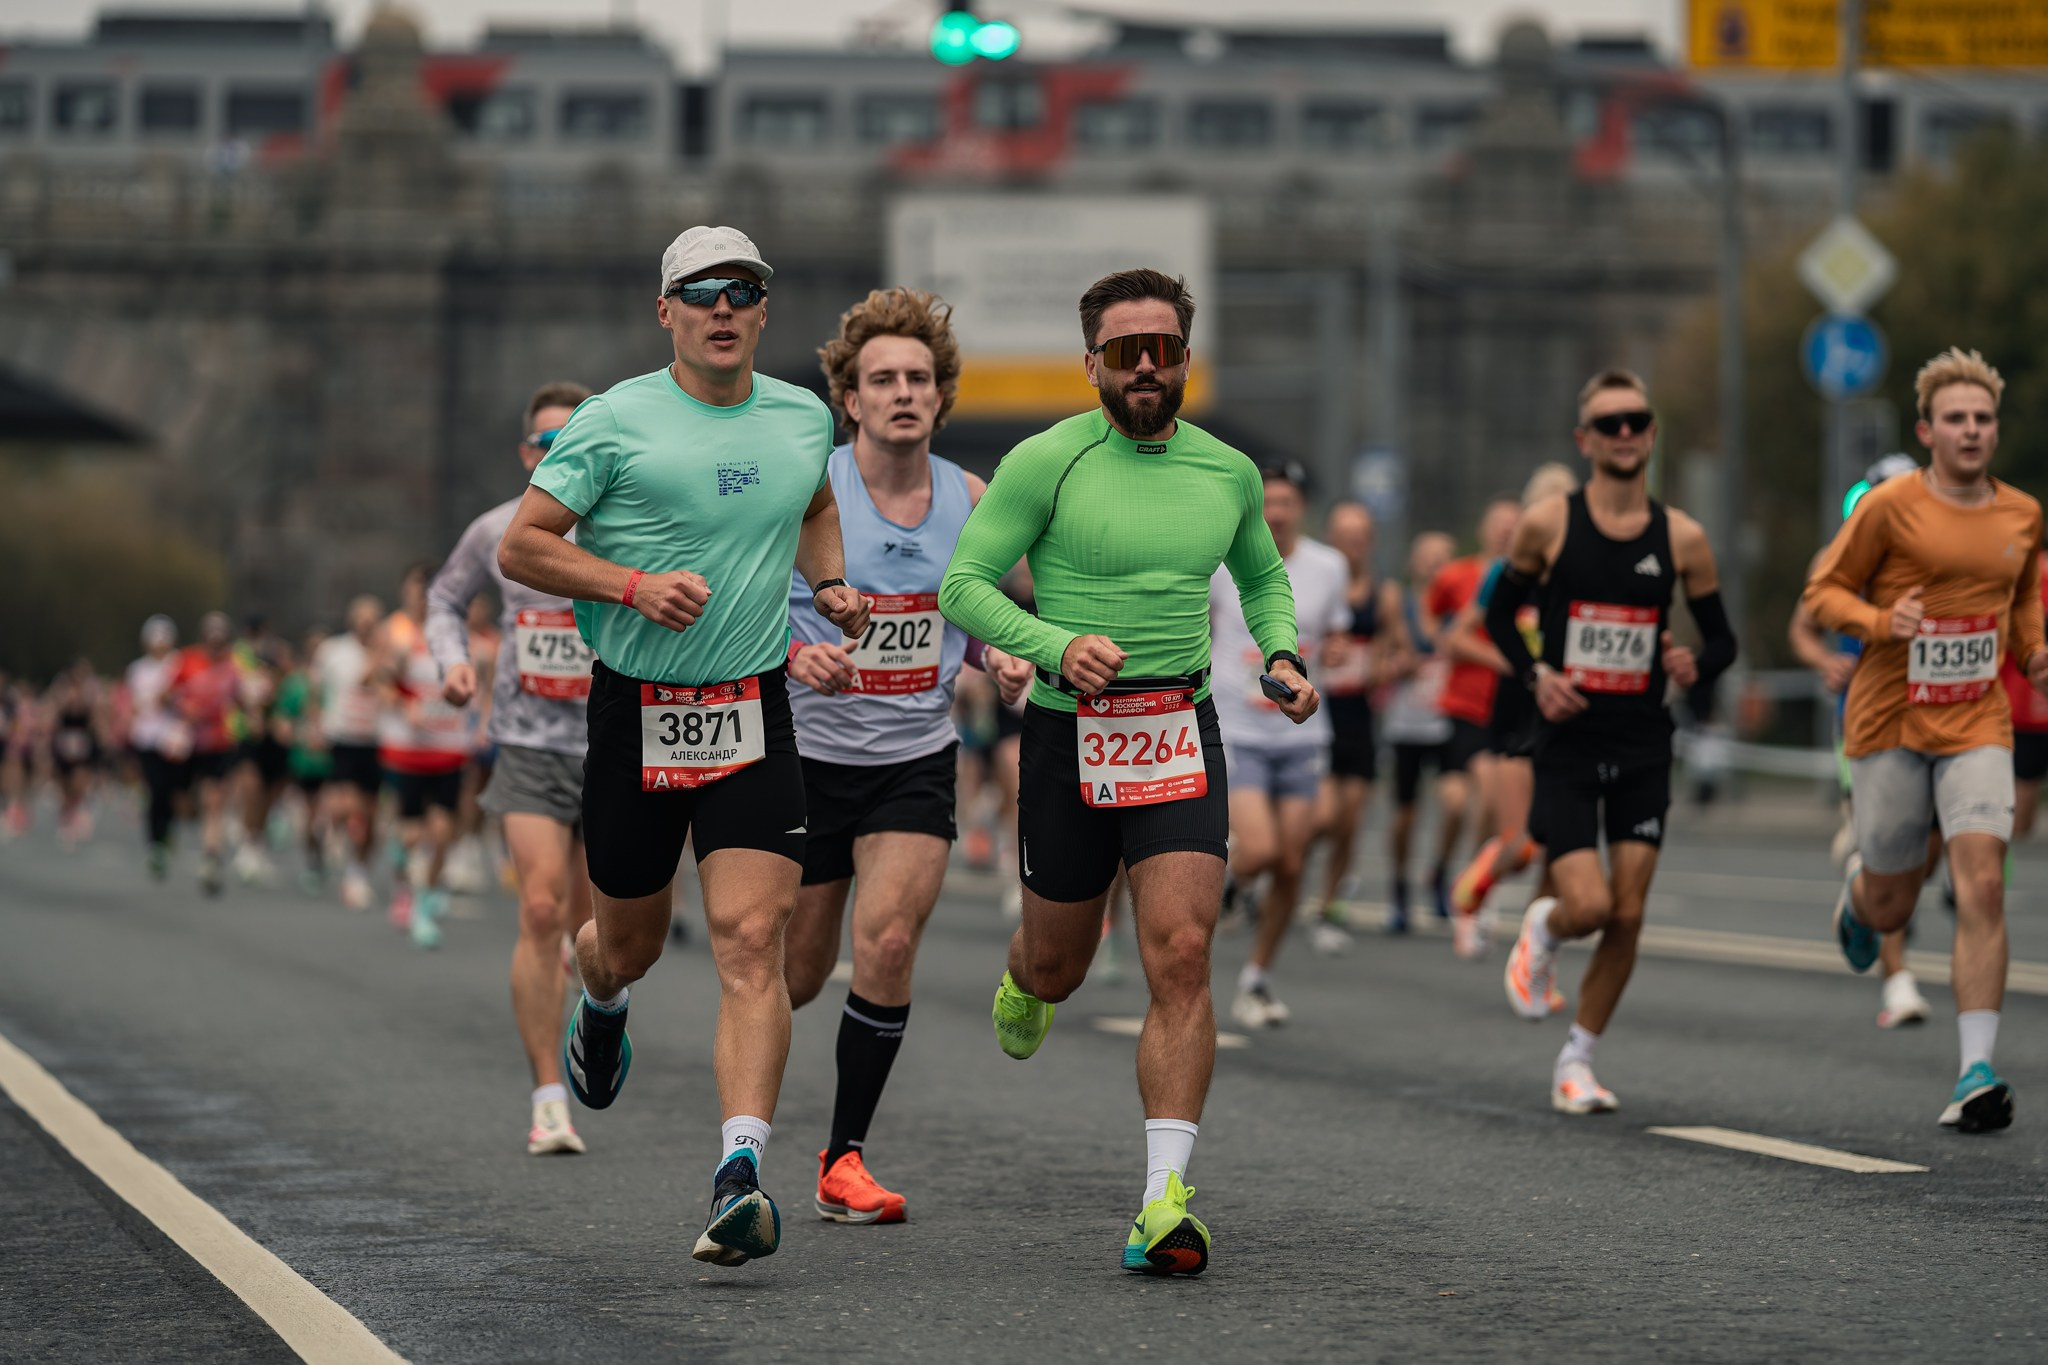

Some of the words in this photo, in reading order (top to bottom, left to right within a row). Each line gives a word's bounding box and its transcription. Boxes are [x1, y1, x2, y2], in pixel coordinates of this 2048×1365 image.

[861, 618, 931, 650] 7202
[1580, 626, 1645, 658] 8576
[880, 655, 912, 664] АНТОН
[1914, 636, 1994, 668] 13350
[1113, 700, 1157, 709] МОСКОВСКИЙ
[659, 709, 742, 746] 3871
[670, 749, 738, 761] АЛЕКСАНДР
[1083, 726, 1198, 767] 32264
